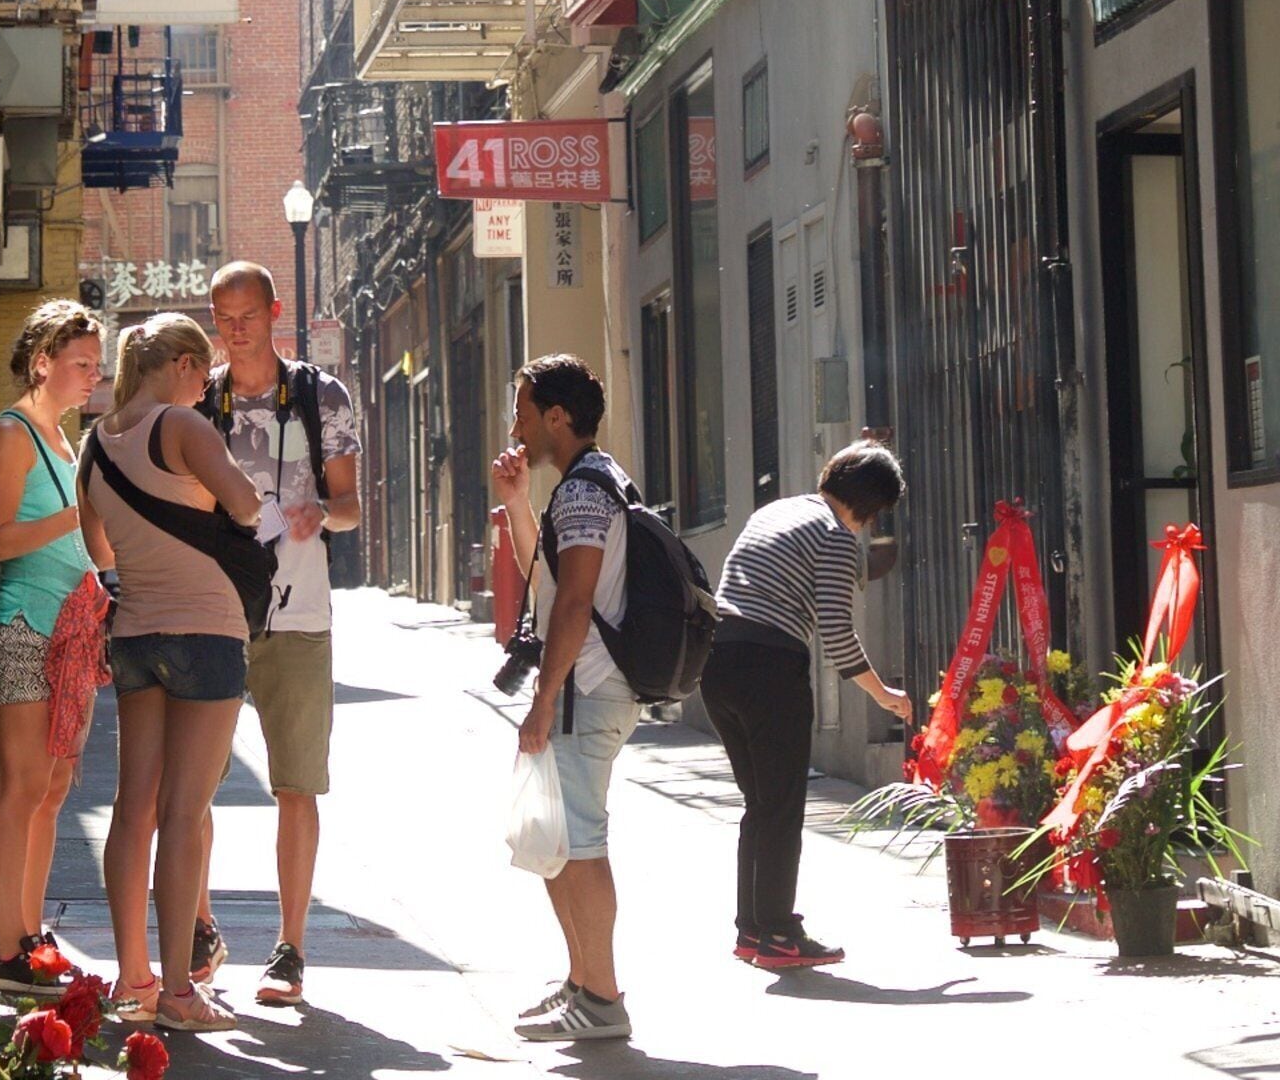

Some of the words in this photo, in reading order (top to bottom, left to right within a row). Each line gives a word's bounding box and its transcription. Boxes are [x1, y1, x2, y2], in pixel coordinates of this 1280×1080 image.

[446, 138, 507, 188] 41
[508, 135, 601, 169] ROSS
[486, 229, 512, 241] TIME
[488, 216, 511, 226] ANY
[975, 572, 998, 623] STEPHEN
